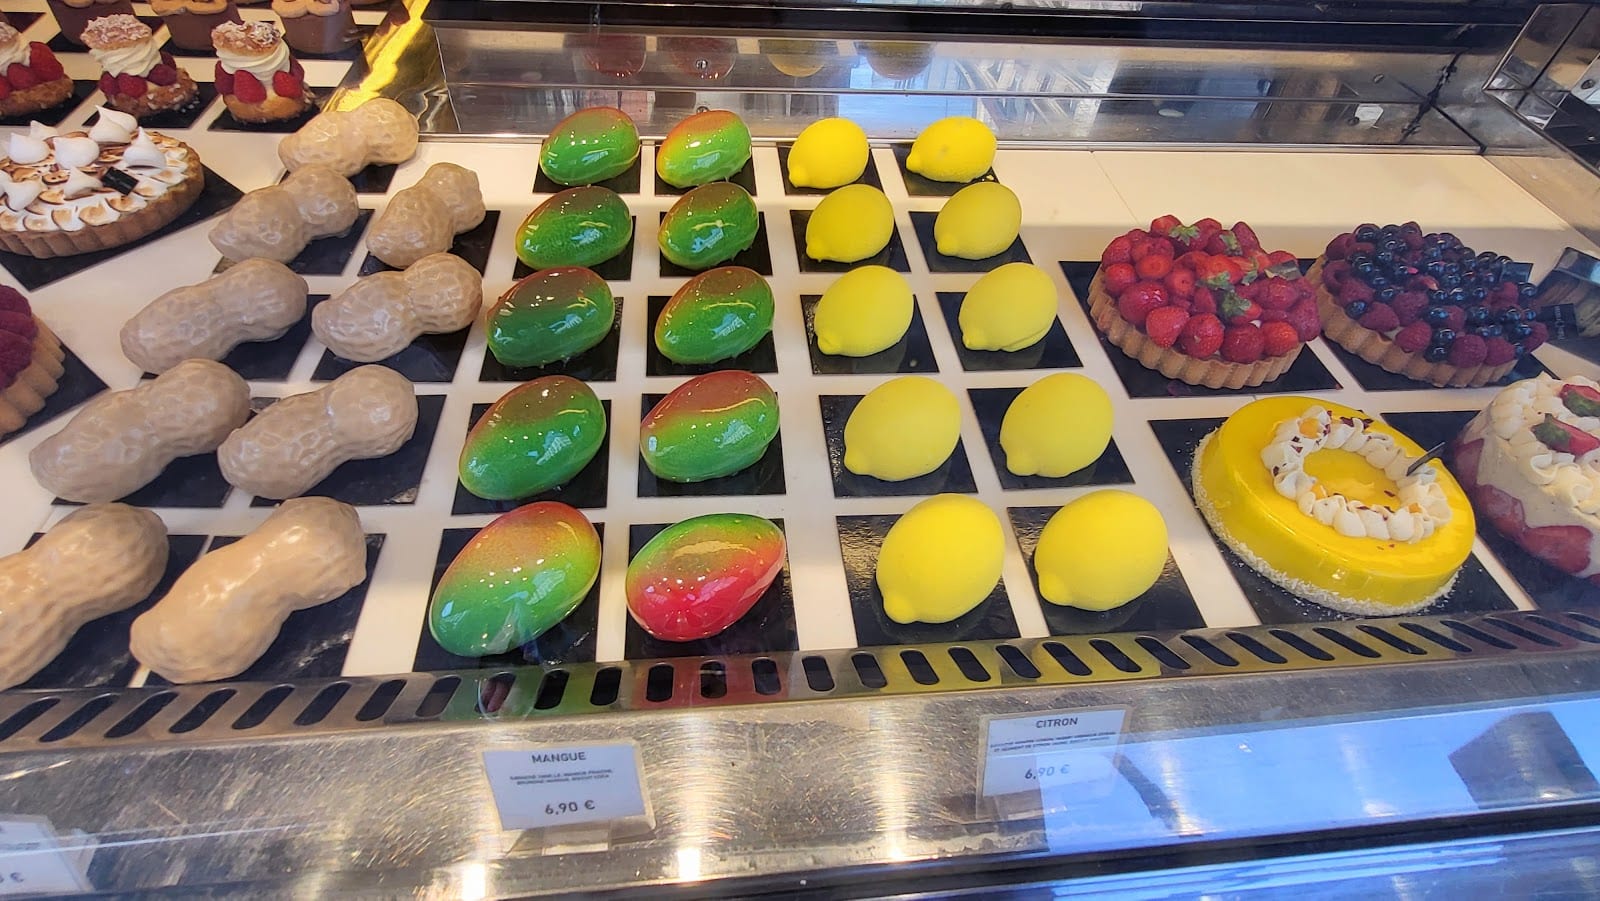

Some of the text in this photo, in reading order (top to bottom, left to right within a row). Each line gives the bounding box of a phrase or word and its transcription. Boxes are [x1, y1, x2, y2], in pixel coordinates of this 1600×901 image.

[1036, 717, 1078, 728] CITRON
[531, 752, 586, 763] MANGUE
[1060, 764, 1070, 774] €
[584, 799, 595, 810] €
